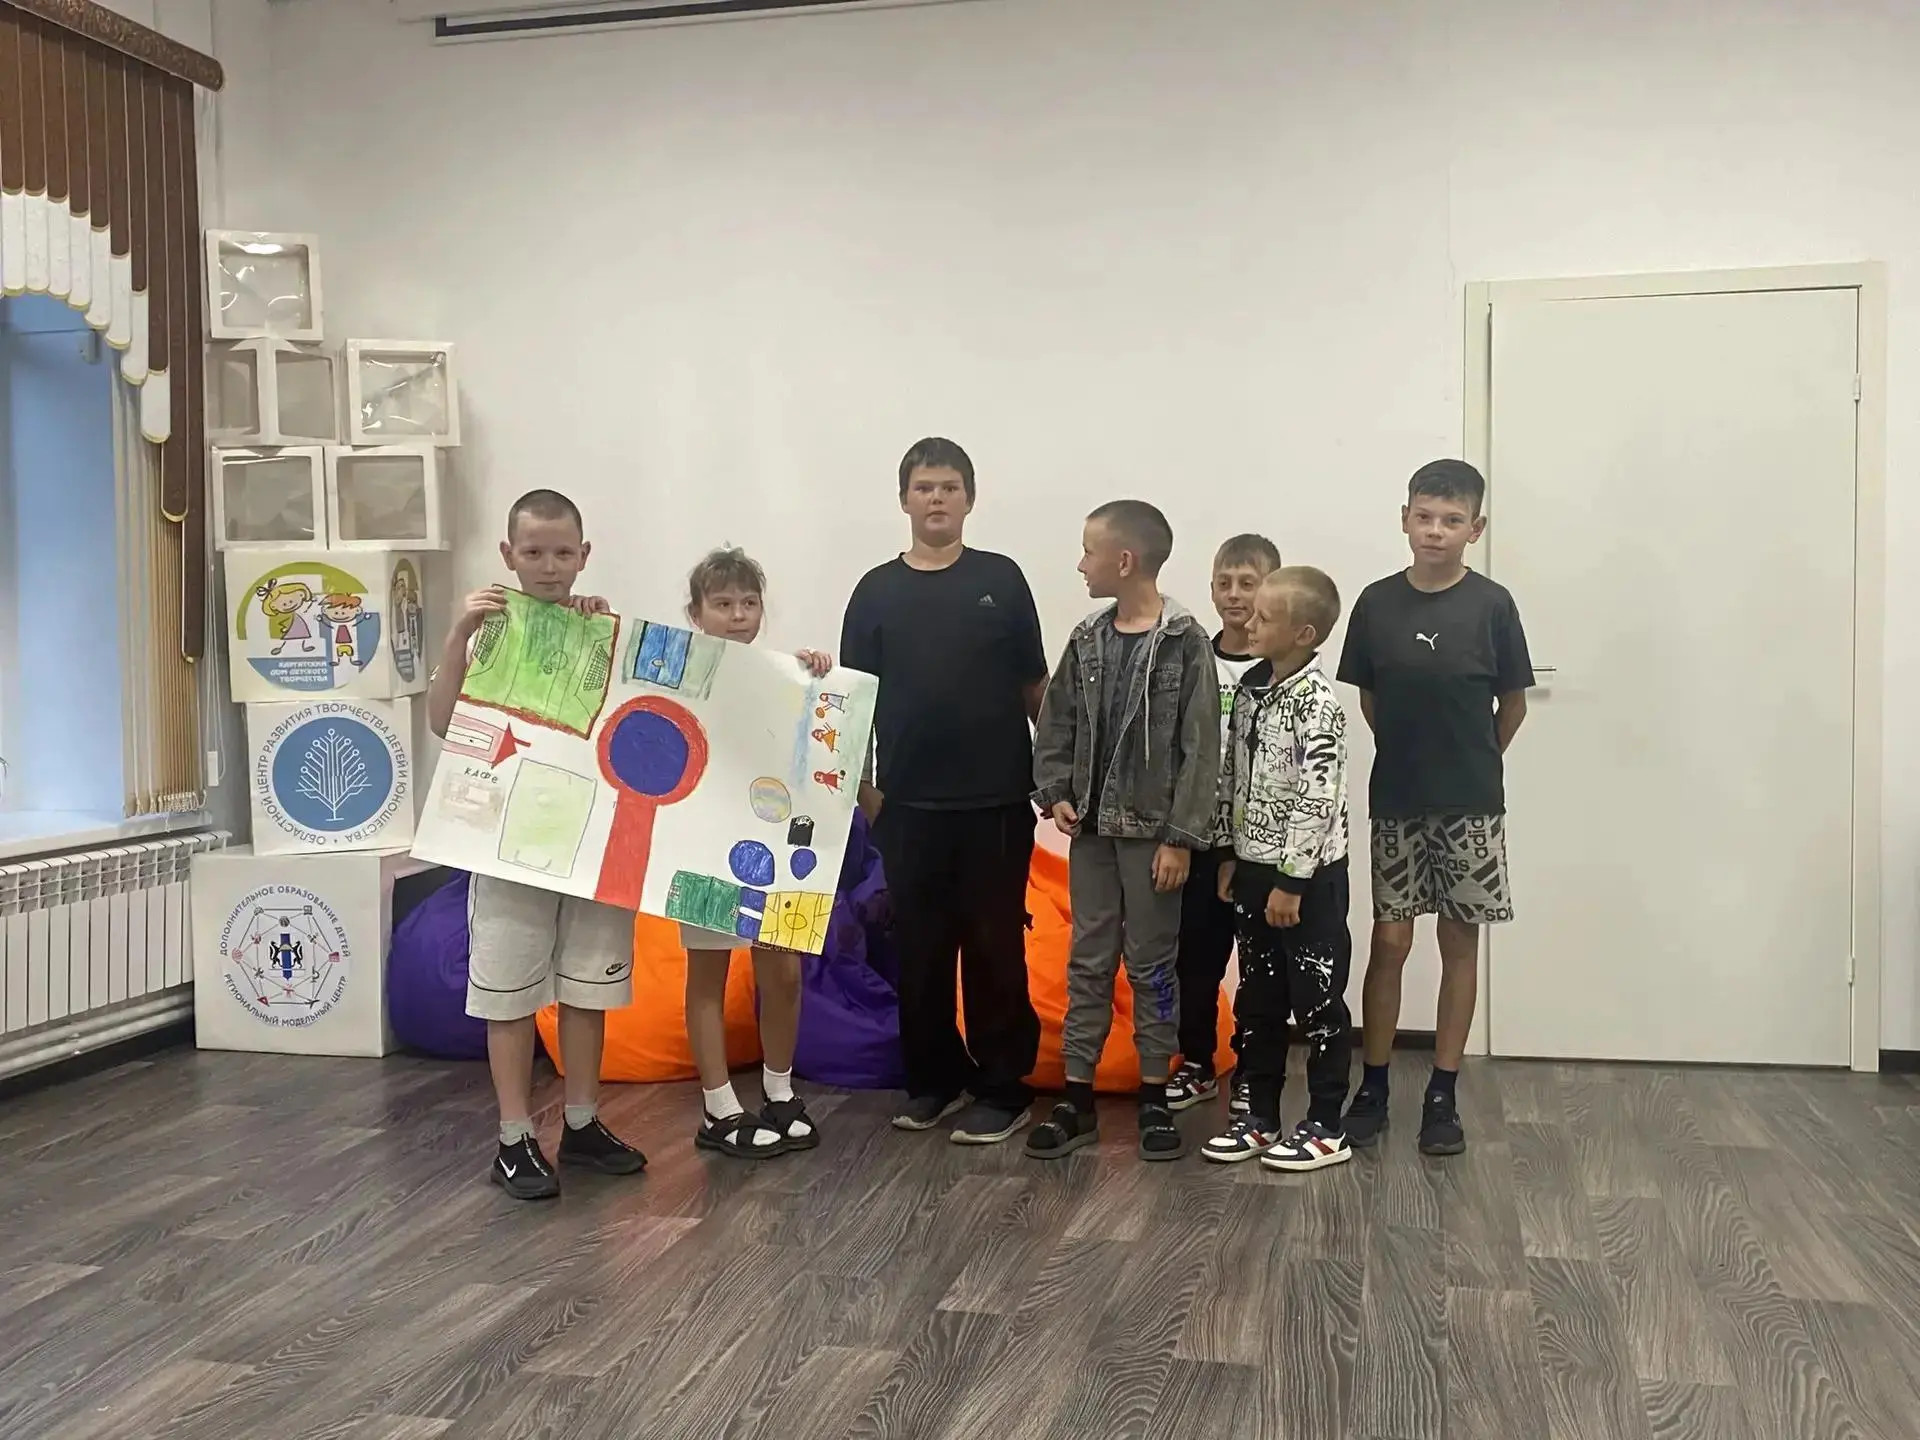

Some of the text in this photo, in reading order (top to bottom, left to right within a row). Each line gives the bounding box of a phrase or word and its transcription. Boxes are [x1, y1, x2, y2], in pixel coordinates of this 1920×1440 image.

[257, 703, 408, 845] ОБЛАСТНОЙ ЦЕНТР РАЗВИТИЯ ТВОРЧЕСТВА ДЕТЕЙ И ЮНОШЕСТВА
[220, 886, 351, 957] ДОПОЛНИТЕЛЬНОЕ ОБРАЗОВАНИЕ ДЕТЕЙ
[224, 973, 347, 1027] РЕГИОНАЛЬНЫЙ МОДЕЛЬНЫЙ ЦЕНТР
